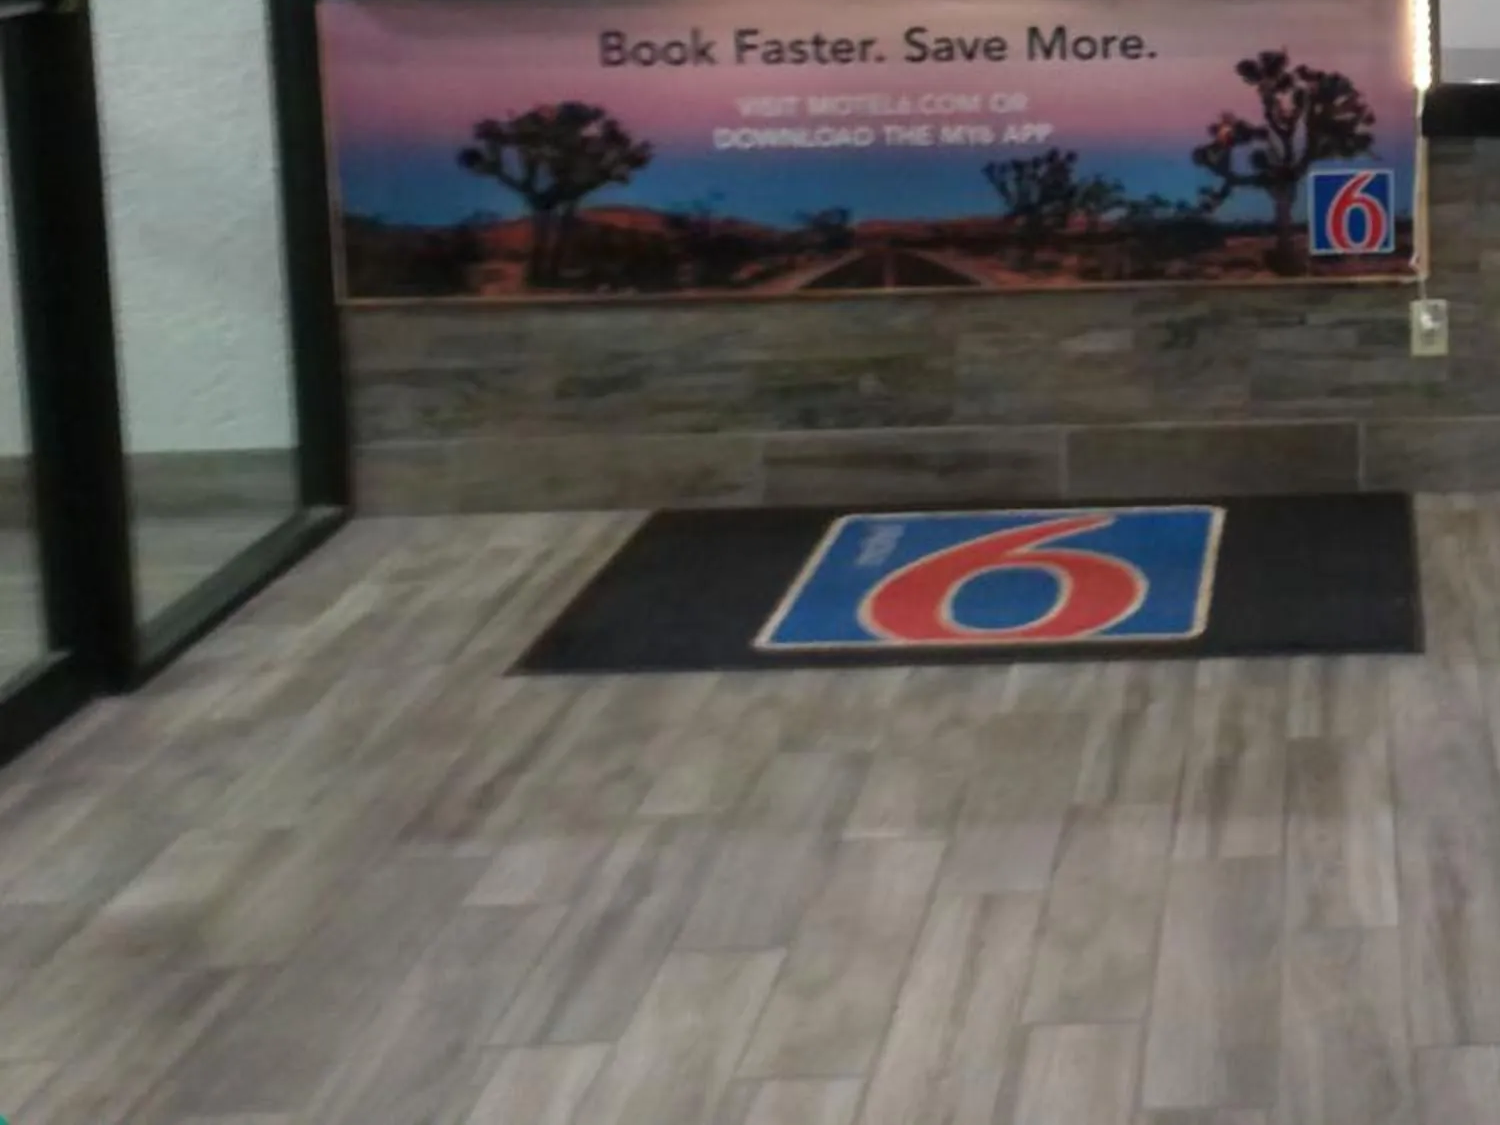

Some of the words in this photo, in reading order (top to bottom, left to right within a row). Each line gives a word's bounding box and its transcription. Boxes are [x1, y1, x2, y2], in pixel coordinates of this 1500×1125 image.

[599, 27, 720, 68] Book
[733, 27, 889, 66] Faster.
[903, 25, 1009, 64] Save
[1026, 24, 1159, 62] More.
[712, 126, 876, 150] DOWNLOAD
[883, 124, 935, 147] THE
[1325, 169, 1388, 253] 6
[857, 511, 1150, 644] 6
